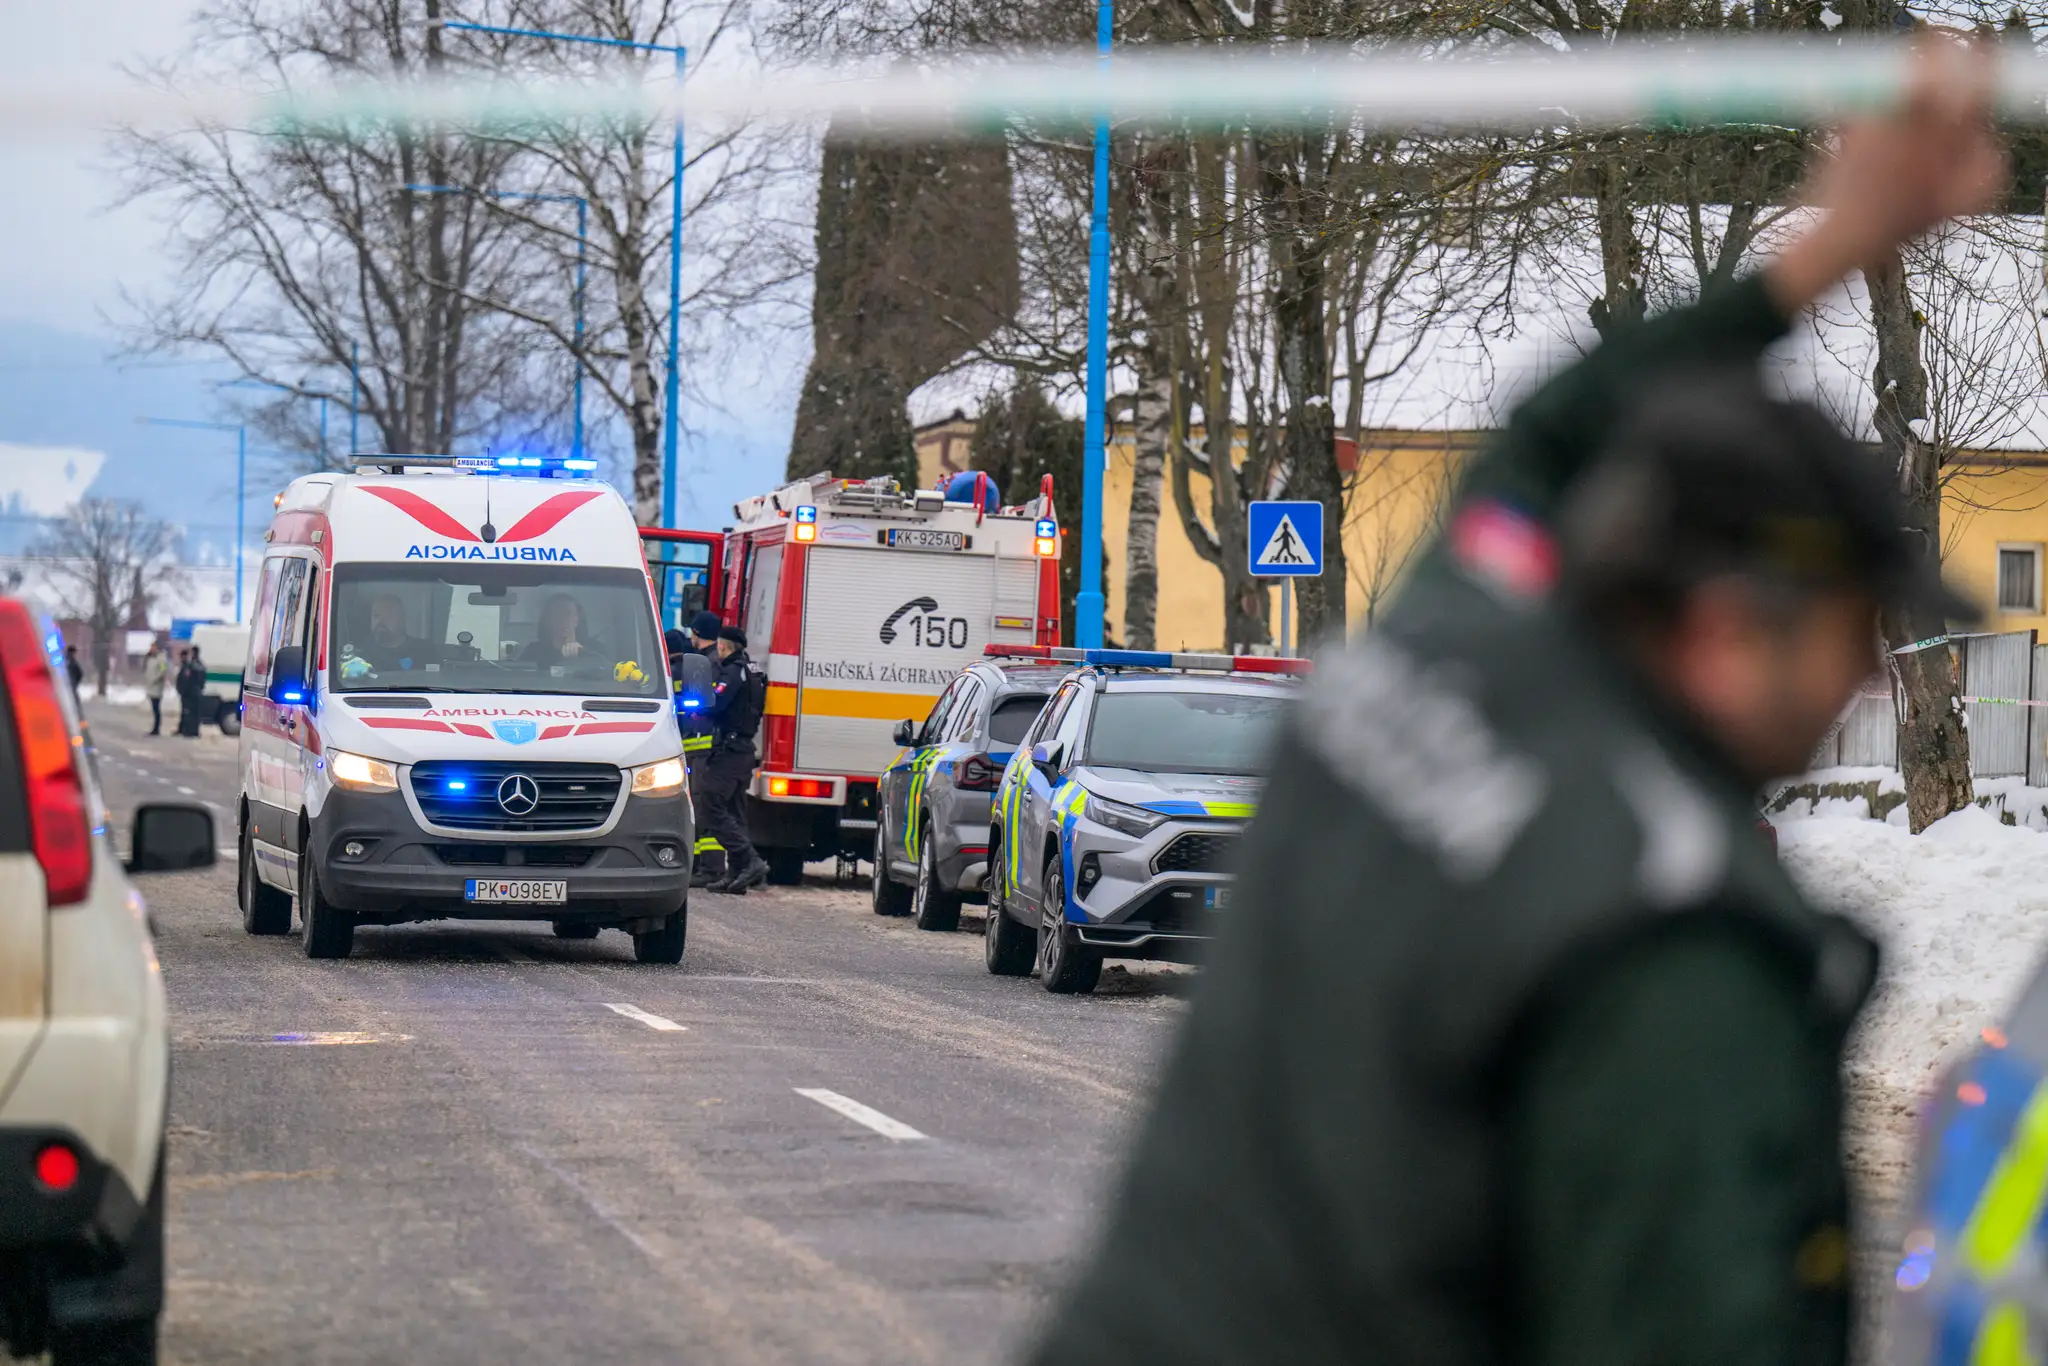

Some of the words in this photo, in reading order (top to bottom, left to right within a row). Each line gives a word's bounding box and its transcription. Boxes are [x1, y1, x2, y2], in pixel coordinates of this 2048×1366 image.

[457, 459, 494, 467] AMBULANCIA
[909, 615, 968, 649] 150
[804, 660, 875, 681] HASIČSKÁ
[880, 662, 958, 686] ZÁCHRANN
[423, 708, 598, 720] AMBULANCIA
